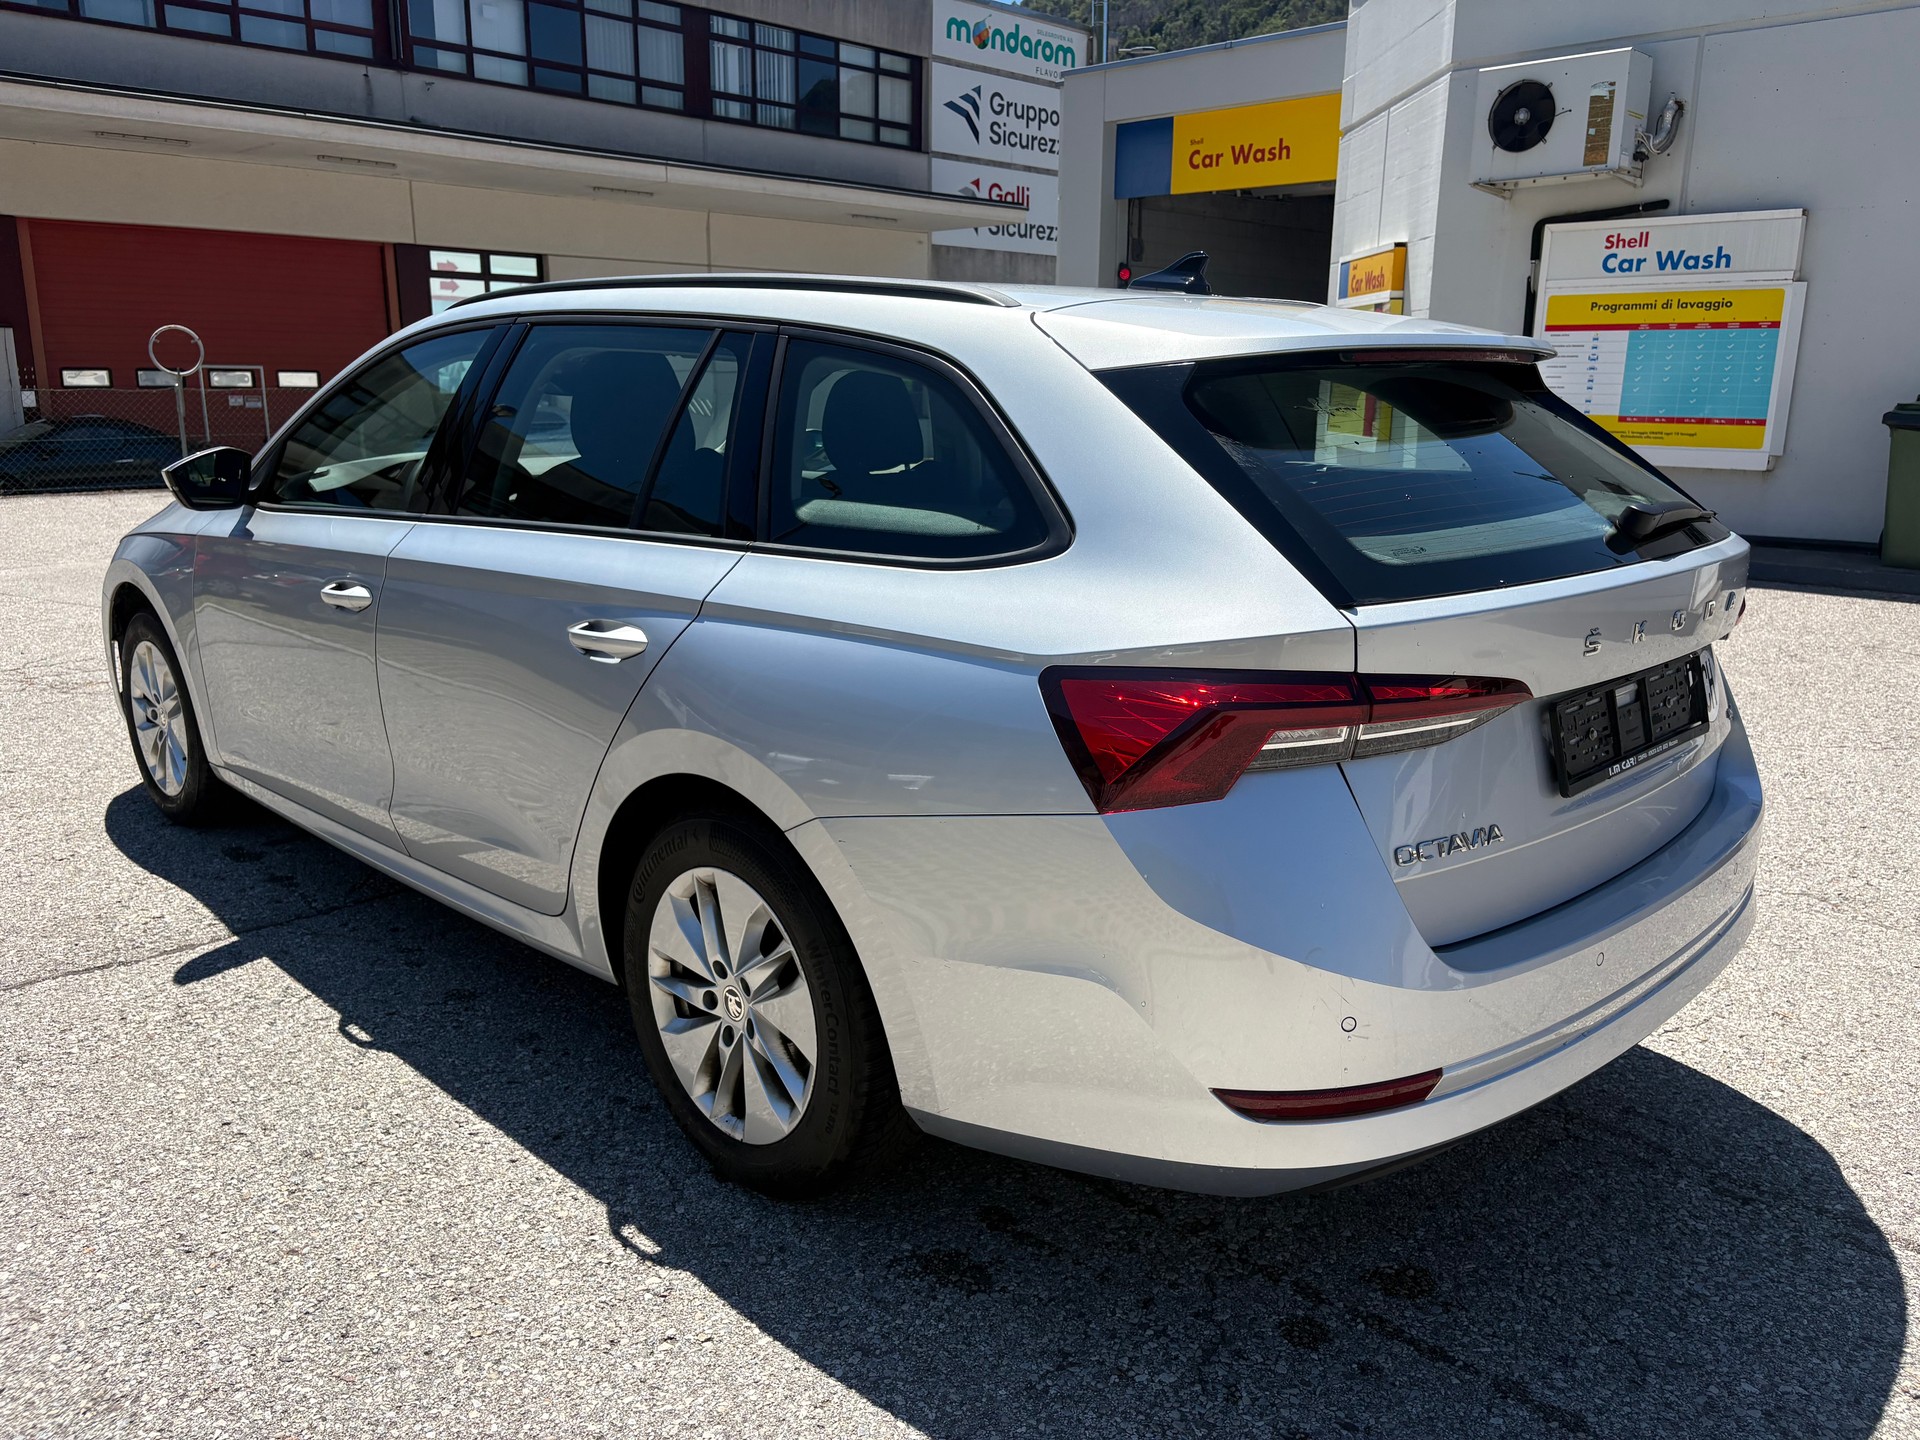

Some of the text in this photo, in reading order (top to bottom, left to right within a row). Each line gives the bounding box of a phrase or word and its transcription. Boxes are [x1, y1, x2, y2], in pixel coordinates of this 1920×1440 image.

[1035, 66, 1062, 79] FLAVO
[989, 91, 1060, 131] Gruppo
[1188, 137, 1291, 170] Car Wash
[988, 182, 1030, 209] Galli
[1604, 231, 1650, 250] Shell
[1602, 245, 1732, 274] Car Wash
[1350, 265, 1385, 293] Car Wash
[1590, 297, 1733, 314] Programmi di lavaggio
[1701, 657, 1718, 713] CH
[1394, 824, 1504, 867] OCTAVIA
[632, 828, 688, 905] Continental
[804, 938, 844, 1096] WinterContact
